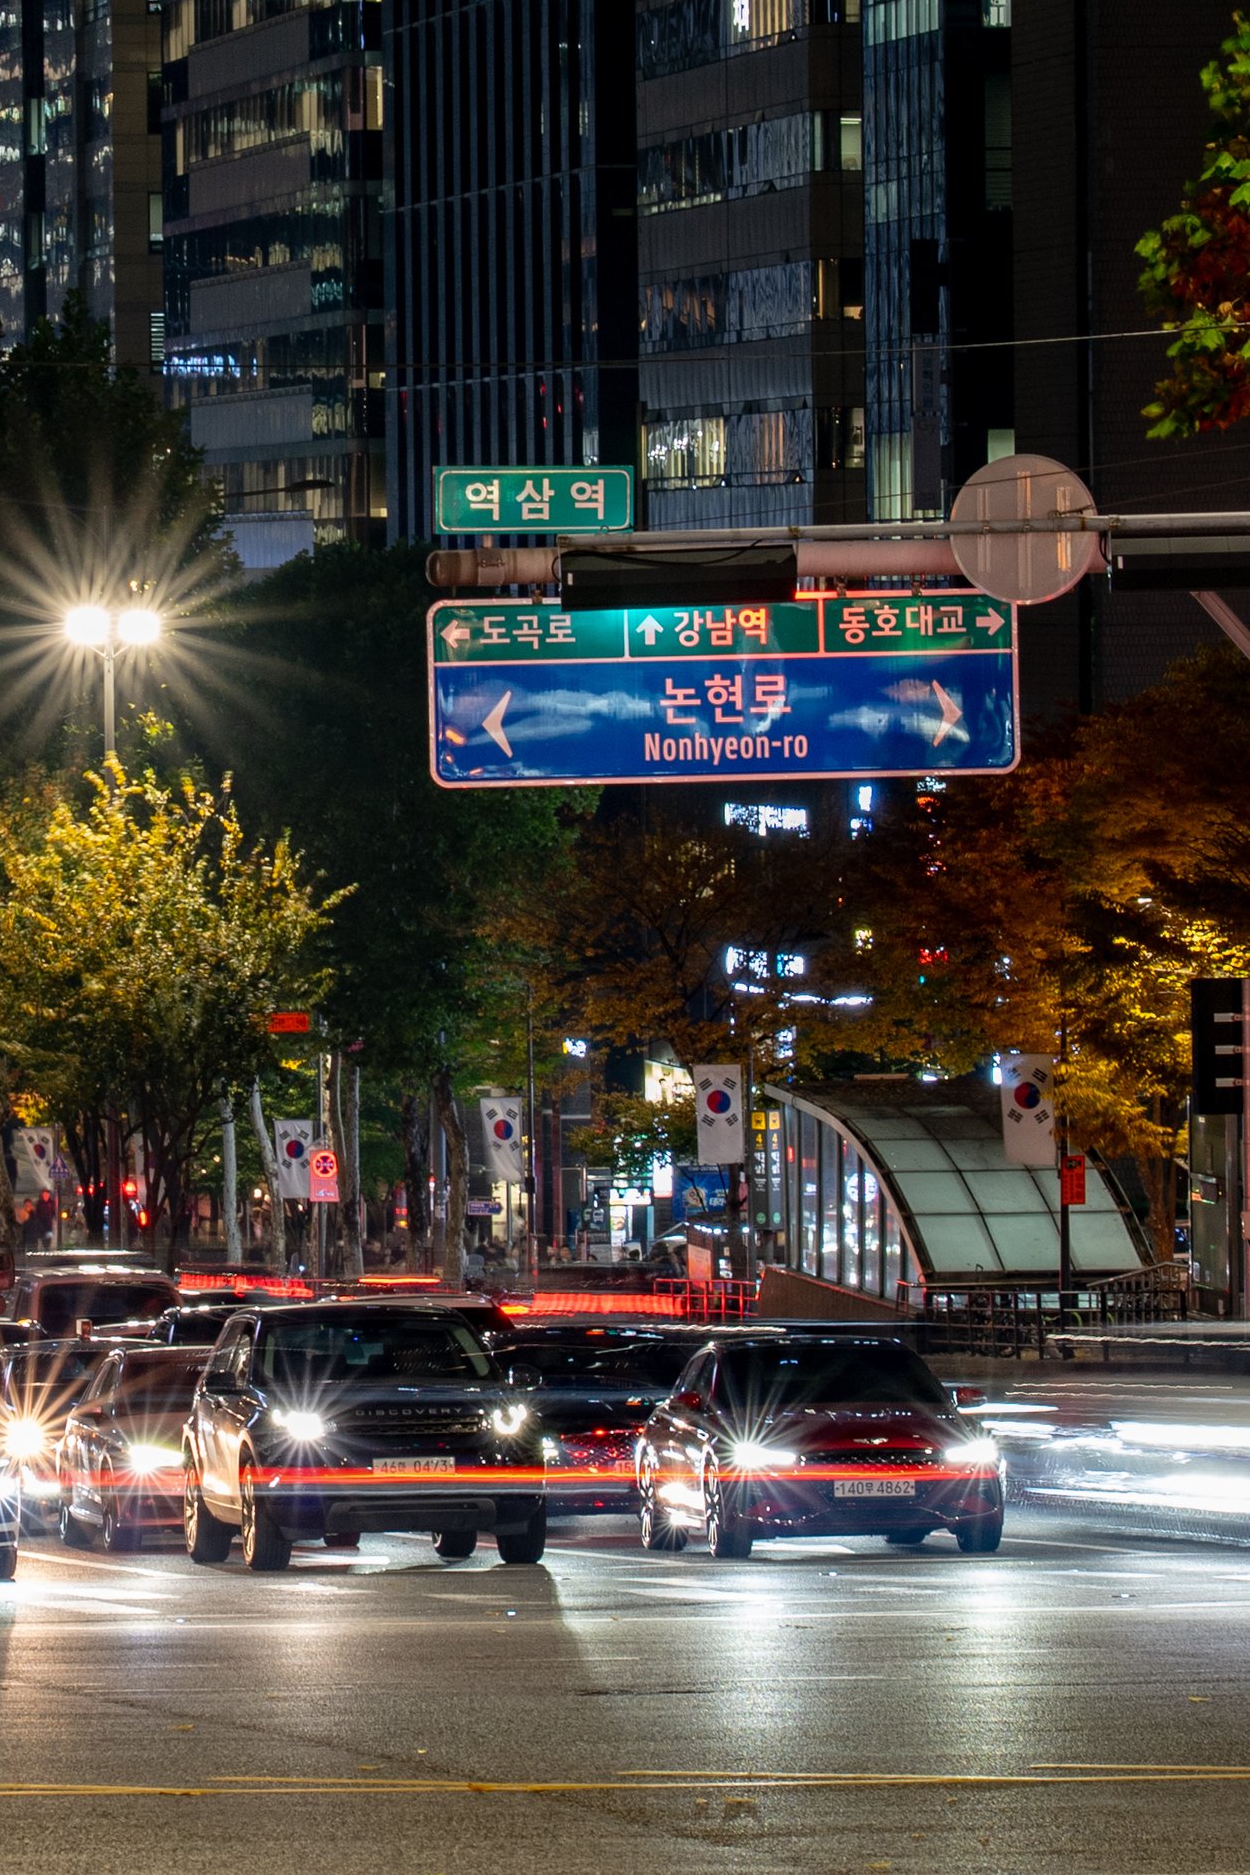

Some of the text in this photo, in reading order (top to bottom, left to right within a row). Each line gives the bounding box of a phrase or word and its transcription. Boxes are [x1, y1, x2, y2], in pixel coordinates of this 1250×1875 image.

[465, 478, 606, 521] 역삼역
[480, 614, 577, 648] 도곡로
[672, 608, 768, 646] 강남역
[838, 605, 968, 644] 동호대교
[658, 674, 792, 725] 논현로
[644, 733, 808, 765] Nonhyeon-ro
[355, 1408, 463, 1416] DISCOVERY
[413, 1460, 449, 1473] 0473
[839, 1481, 910, 1494] 140무 4862
